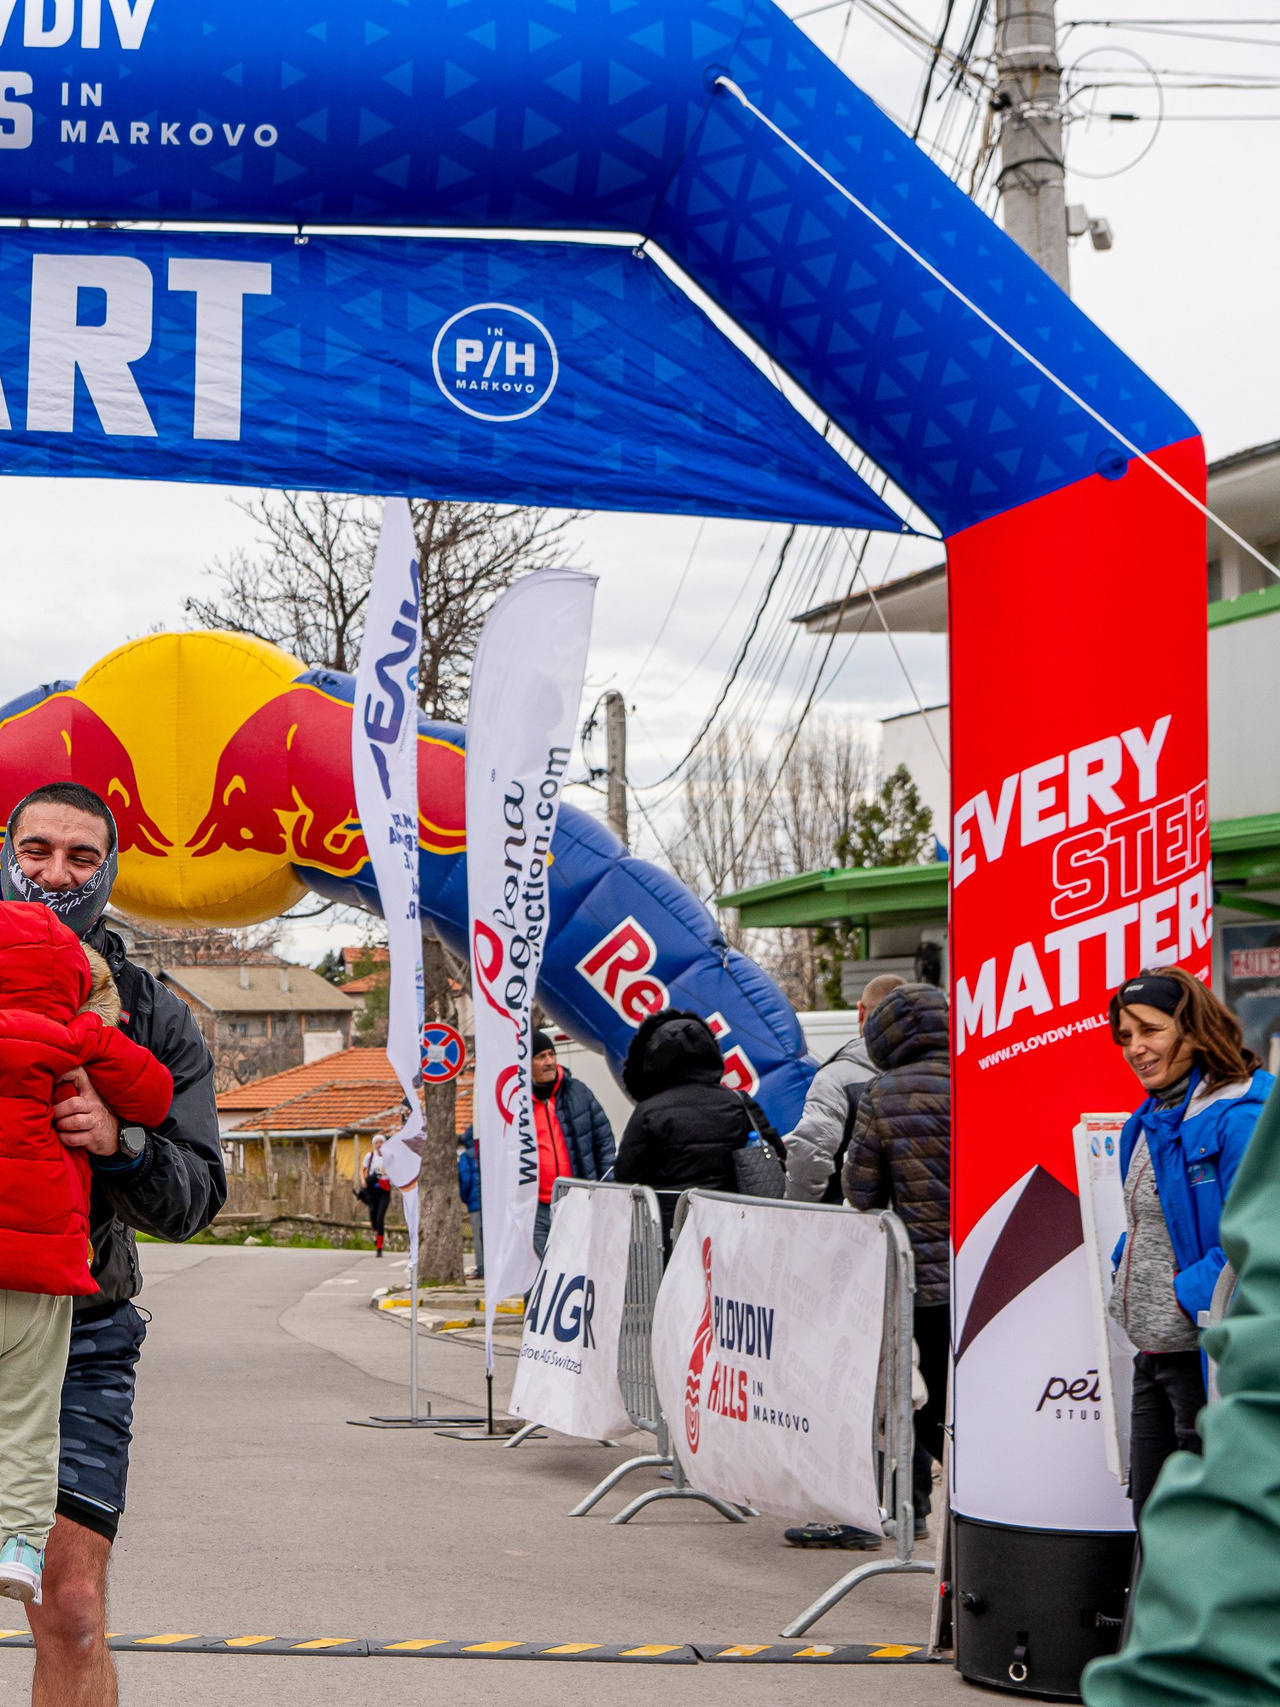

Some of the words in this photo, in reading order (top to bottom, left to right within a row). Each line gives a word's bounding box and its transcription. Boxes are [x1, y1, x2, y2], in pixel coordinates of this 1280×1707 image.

[61, 82, 102, 107] IN
[60, 119, 278, 147] MARKOVO
[487, 326, 503, 337] IN
[455, 338, 535, 378] P/H
[455, 379, 535, 394] MARKOVO
[953, 714, 1172, 889] EVERY
[1050, 779, 1209, 921] STEP
[956, 860, 1213, 1056] MATTER
[978, 1012, 1111, 1071] WWW.PLOVDIV-HILL
[714, 1295, 774, 1360] PLOVDIV
[753, 1380, 763, 1397] IN
[753, 1405, 809, 1433] MARKOVO
